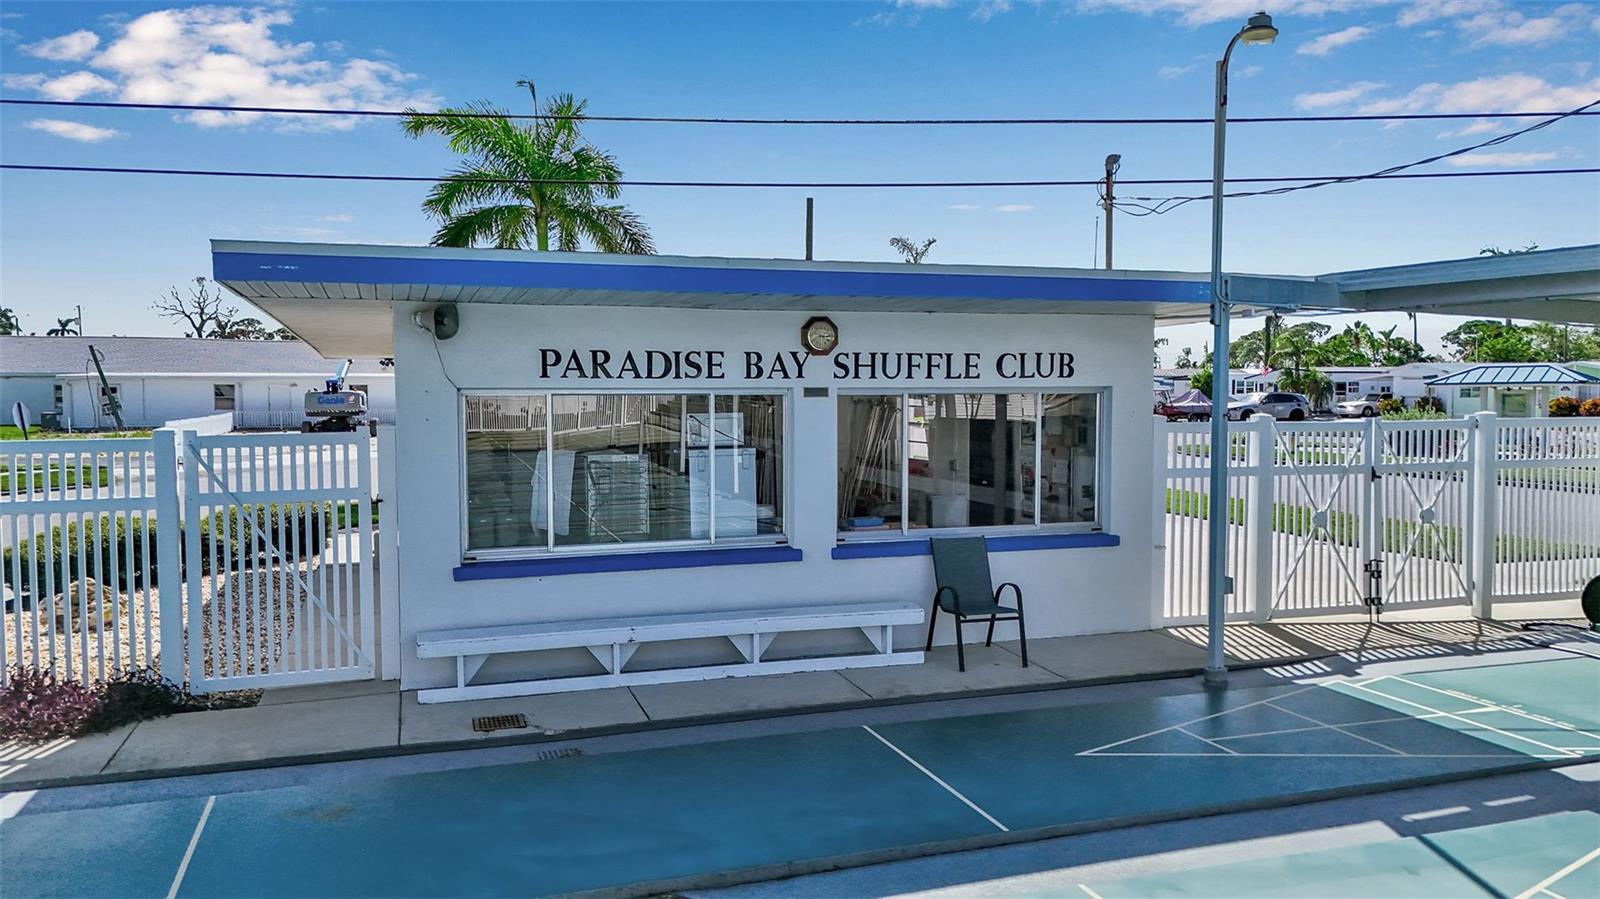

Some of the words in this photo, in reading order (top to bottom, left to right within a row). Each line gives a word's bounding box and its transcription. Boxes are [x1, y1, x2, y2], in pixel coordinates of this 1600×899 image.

[538, 349, 725, 379] PARADISE
[744, 351, 811, 379] BAY
[833, 352, 981, 379] SHUFFLE
[996, 352, 1075, 379] CLUB
